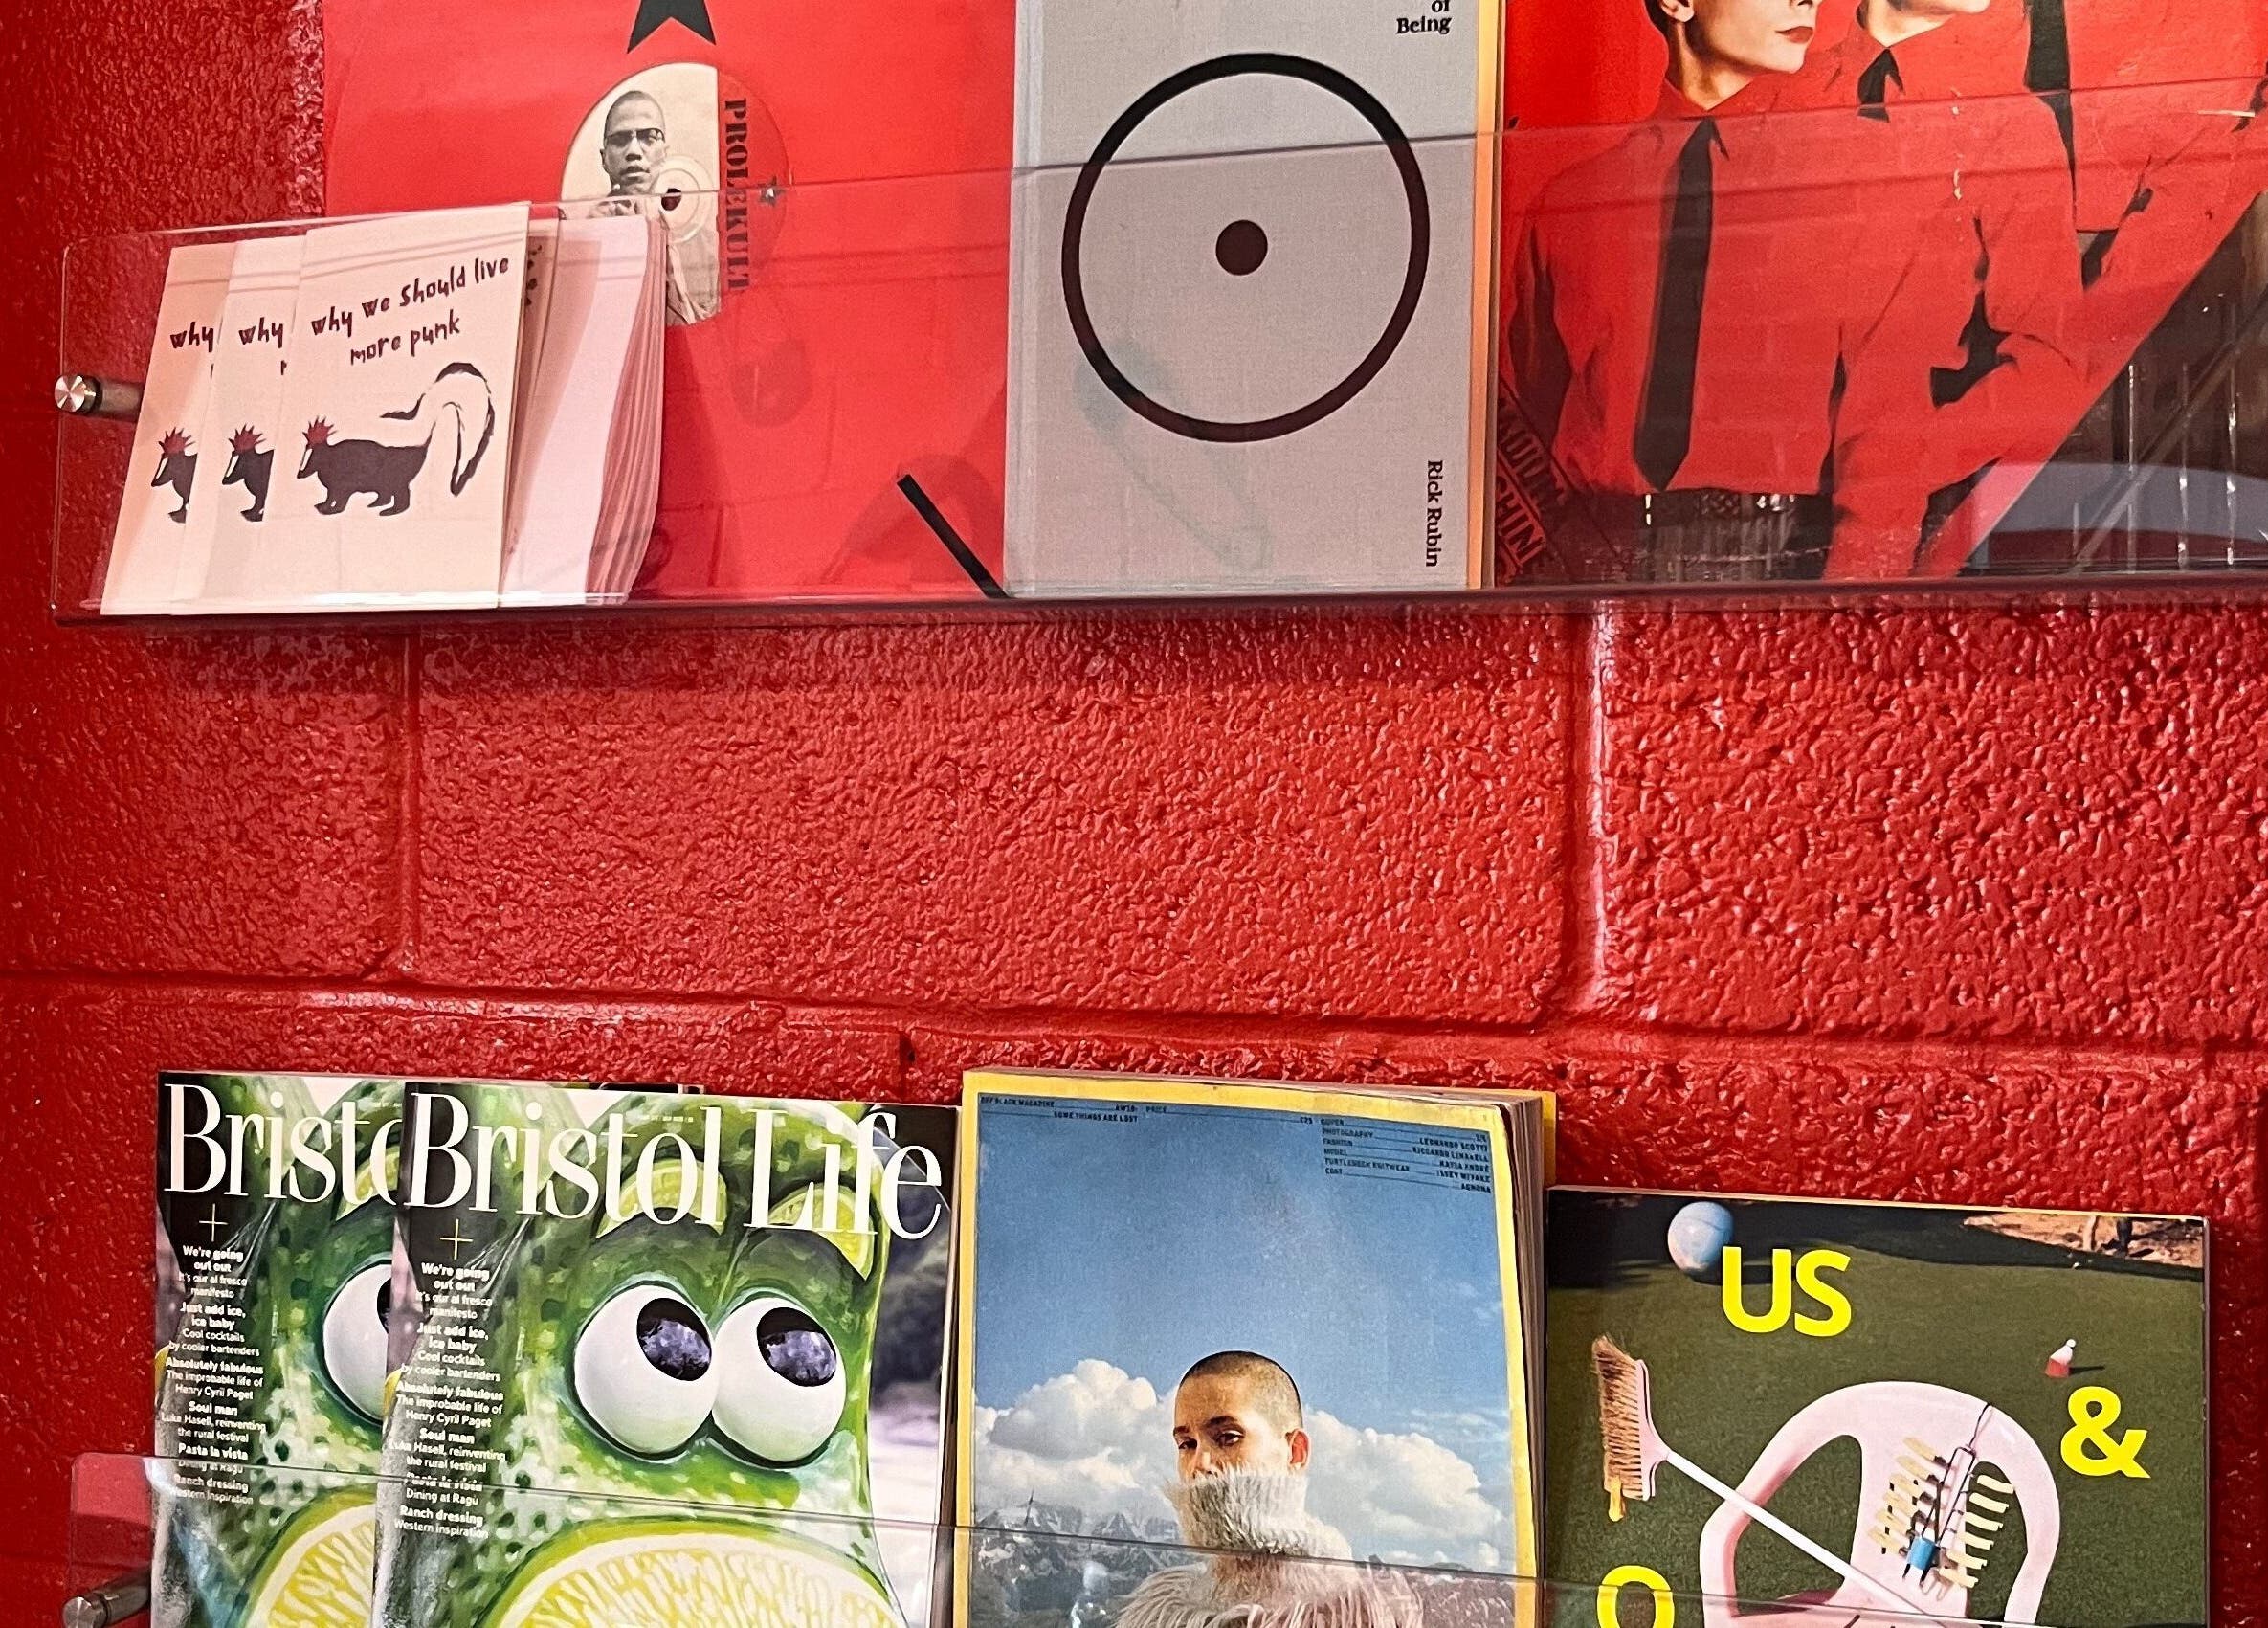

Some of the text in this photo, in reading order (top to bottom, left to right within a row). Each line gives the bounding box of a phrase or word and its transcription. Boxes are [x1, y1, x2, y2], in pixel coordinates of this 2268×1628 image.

[1396, 15, 1452, 34] Being
[724, 98, 750, 293] PROLEKULT
[310, 306, 353, 338] why
[361, 294, 390, 319] we
[473, 256, 510, 285] live
[169, 321, 214, 353] why
[238, 317, 284, 349] why
[350, 308, 461, 366] more punk
[1425, 459, 1443, 567] Rick Rubin
[404, 1092, 943, 1240] Bristol Life
[183, 1245, 244, 1262] We're going
[194, 1261, 232, 1272] out out
[421, 1262, 490, 1282] We're going
[210, 1275, 218, 1284] al
[219, 1275, 248, 1286] fresco
[433, 1281, 476, 1292] out out
[191, 1287, 235, 1299] manifesto
[451, 1295, 459, 1304] al
[462, 1294, 492, 1306] fresco
[1722, 1246, 1851, 1338] US
[180, 1302, 203, 1313] Just
[204, 1305, 225, 1315] add
[430, 1306, 478, 1319] manifesto
[191, 1314, 235, 1331] ice baby
[417, 1322, 442, 1334] Just
[444, 1326, 466, 1336] add
[183, 1328, 245, 1343] Cool cocktails
[168, 1340, 260, 1356] by cooler bartenders
[429, 1336, 478, 1354] ice baby
[166, 1357, 264, 1374] Absolutely fabulous
[418, 1349, 485, 1366] Cool cocktails
[167, 1370, 263, 1387] The improbable life of
[415, 1366, 445, 1375] cooler
[447, 1367, 500, 1382] bartenders
[175, 1384, 254, 1401] Henry Cyril Paget
[396, 1380, 503, 1401] Absolutely fabulous
[189, 1400, 238, 1416] Soul man
[396, 1394, 502, 1415] The improbable life of
[161, 1412, 182, 1422] Luke
[215, 1417, 266, 1433] reinventing
[406, 1409, 491, 1428] Henry Cyril Paget
[177, 1427, 249, 1443] the rural festival
[419, 1428, 475, 1444] Soul man
[2059, 1385, 2151, 1479] &
[179, 1443, 249, 1461] Pasta la vista
[449, 1446, 506, 1461] reinventing
[407, 1456, 486, 1472] the rural festival
[207, 1478, 249, 1493] dressing
[208, 1491, 254, 1505] inspiration
[406, 1488, 437, 1503] Dining
[439, 1491, 451, 1501] at
[400, 1505, 483, 1528] Ranch dressing
[435, 1524, 488, 1539] inspiration
